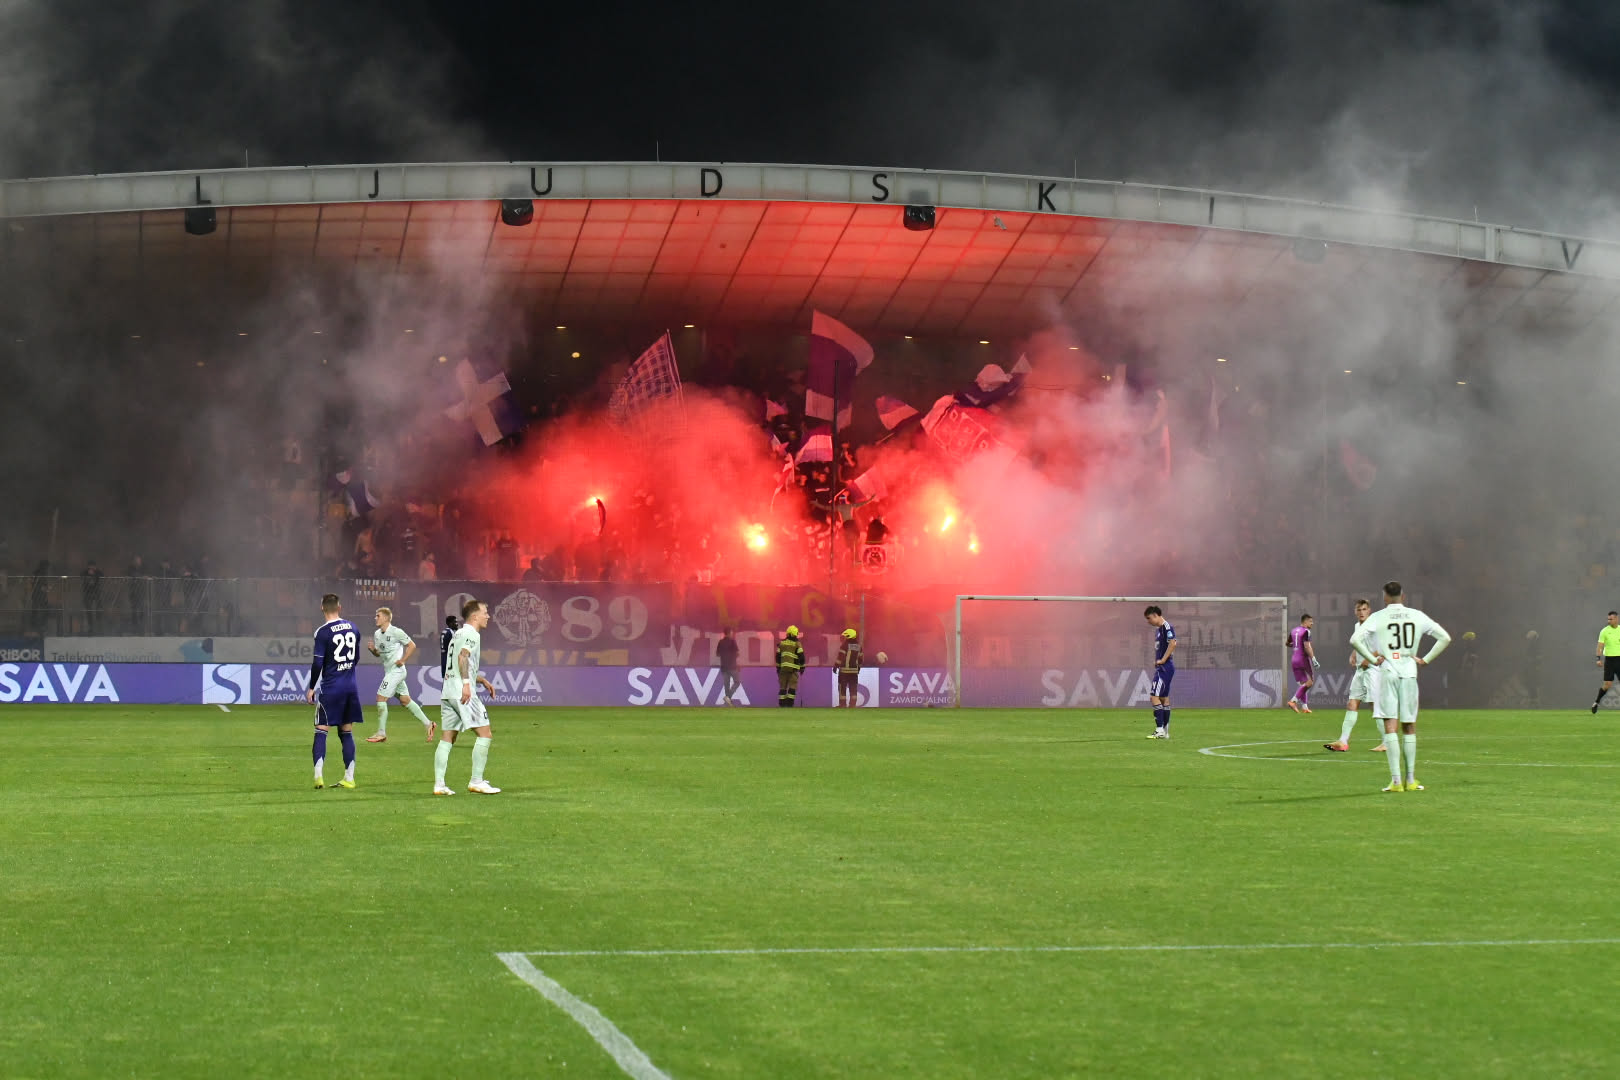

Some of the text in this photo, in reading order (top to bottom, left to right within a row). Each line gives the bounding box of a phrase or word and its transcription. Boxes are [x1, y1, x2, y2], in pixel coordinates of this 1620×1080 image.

[332, 632, 356, 662] 29
[1387, 622, 1415, 650] 30
[0, 663, 120, 702] SAVA
[627, 668, 751, 706] SAVA
[889, 672, 956, 694] SAVA
[1042, 669, 1153, 707] SAVA
[478, 695, 542, 703] AVAROVALNICA
